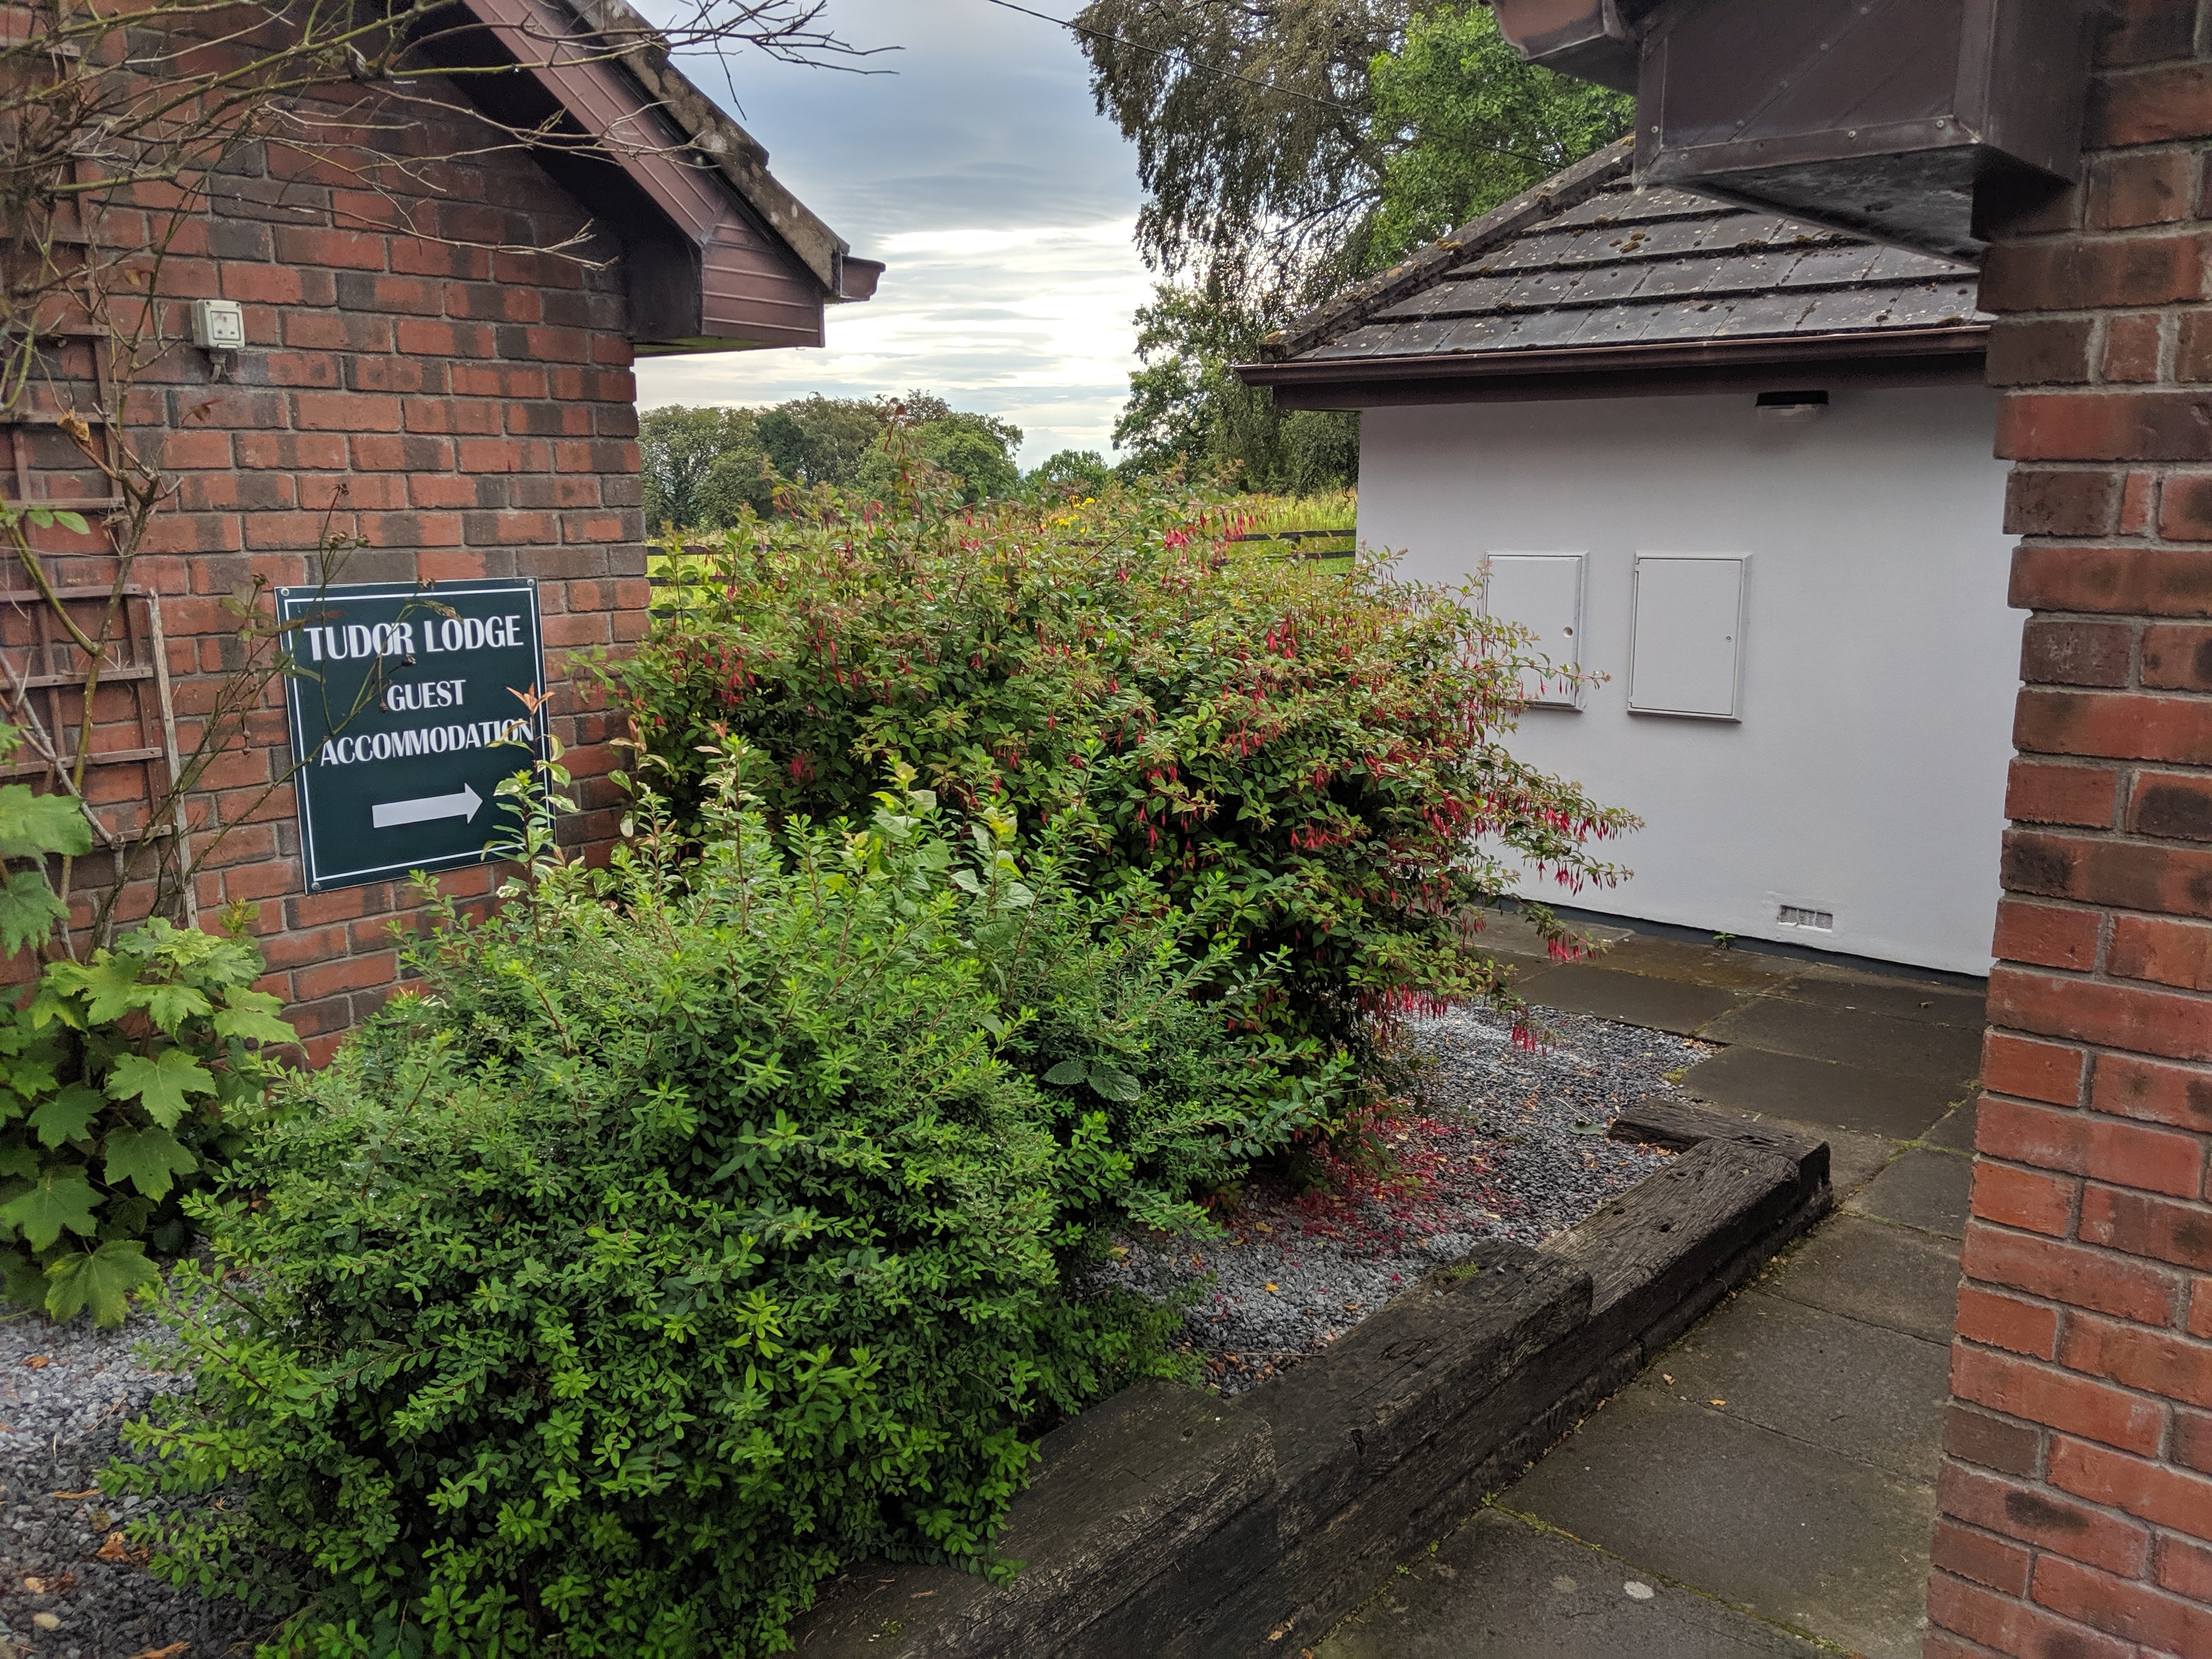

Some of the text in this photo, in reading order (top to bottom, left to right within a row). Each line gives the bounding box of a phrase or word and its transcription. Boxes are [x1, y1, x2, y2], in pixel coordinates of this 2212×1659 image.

[304, 615, 524, 661] TUDOR LODGE
[387, 679, 466, 712] GUEST
[320, 718, 534, 766] ACCOMMODATION
